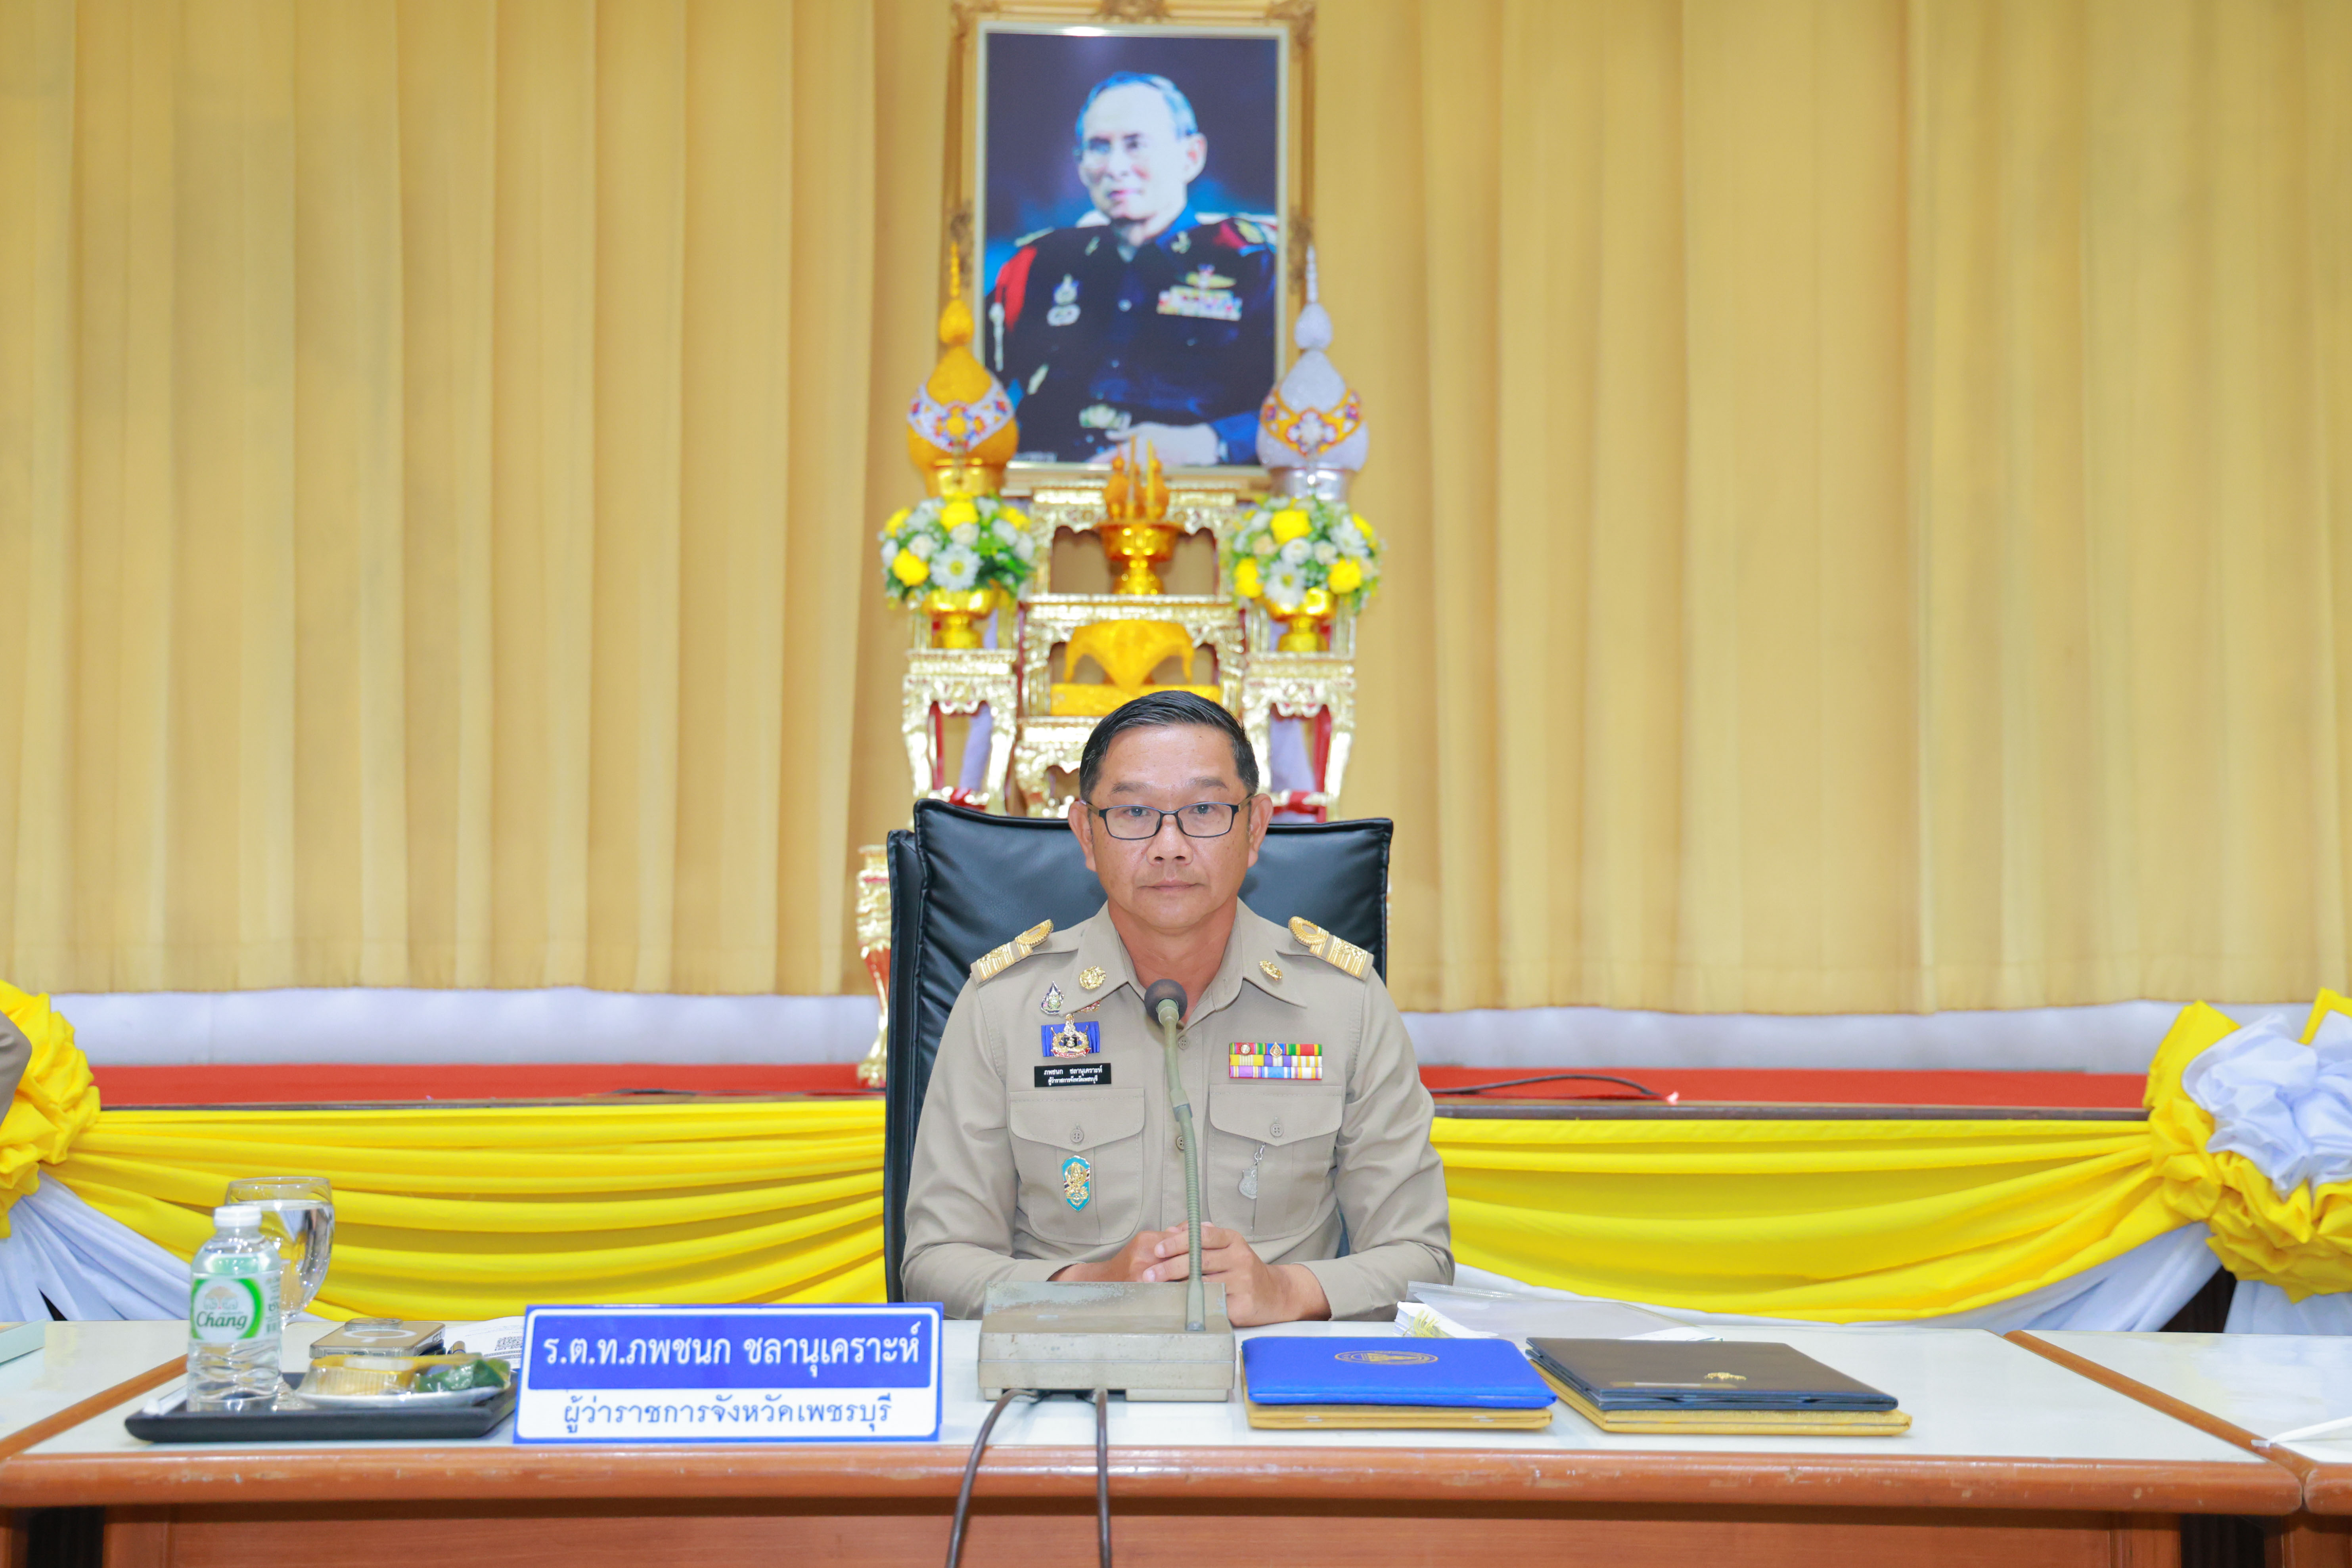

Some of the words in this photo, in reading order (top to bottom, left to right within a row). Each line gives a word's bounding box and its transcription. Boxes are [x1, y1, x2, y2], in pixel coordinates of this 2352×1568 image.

[1070, 1064, 1102, 1076] ชลานุเคราะห์
[197, 1311, 248, 1330] Chang
[543, 1337, 731, 1365] ร.ต.ท.ภพชนก
[743, 1321, 921, 1378] ชลานุเคราะห์
[565, 1393, 891, 1433] ผู้ว่าราชการจังหวัดเพชรบุรี
